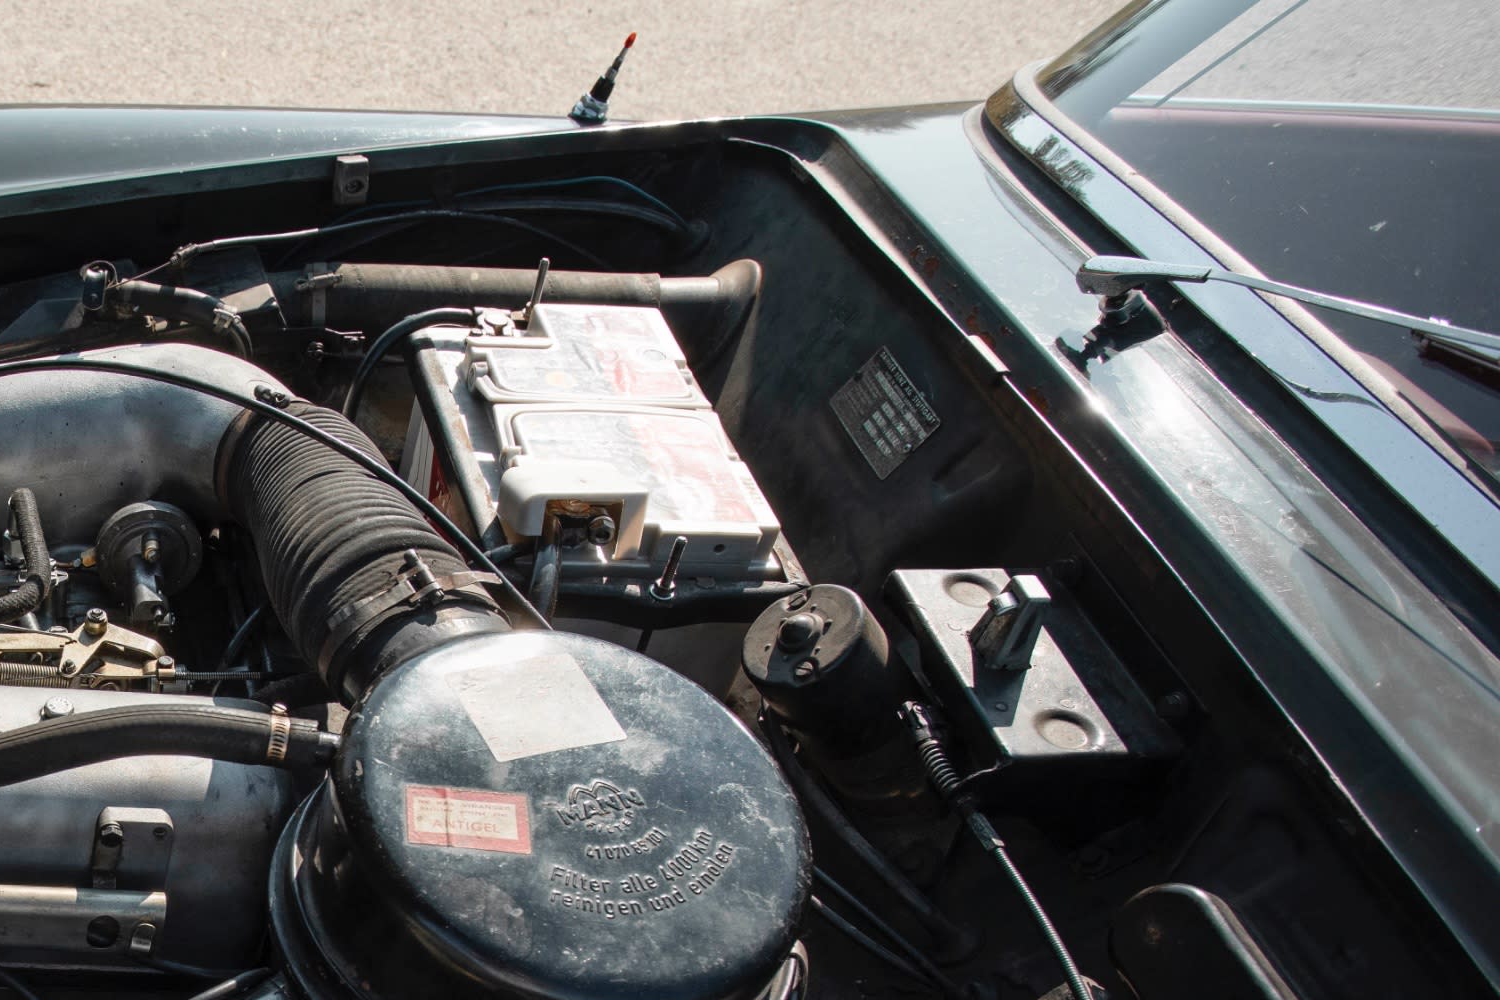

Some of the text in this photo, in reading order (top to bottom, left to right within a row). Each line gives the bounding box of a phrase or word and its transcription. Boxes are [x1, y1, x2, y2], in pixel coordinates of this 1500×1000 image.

[556, 787, 645, 826] MANN
[431, 820, 501, 834] ANTIGEL
[604, 844, 631, 860] 070
[549, 841, 735, 919] reinigen und einölen
[550, 865, 611, 894] Filter
[620, 873, 658, 894] alle
